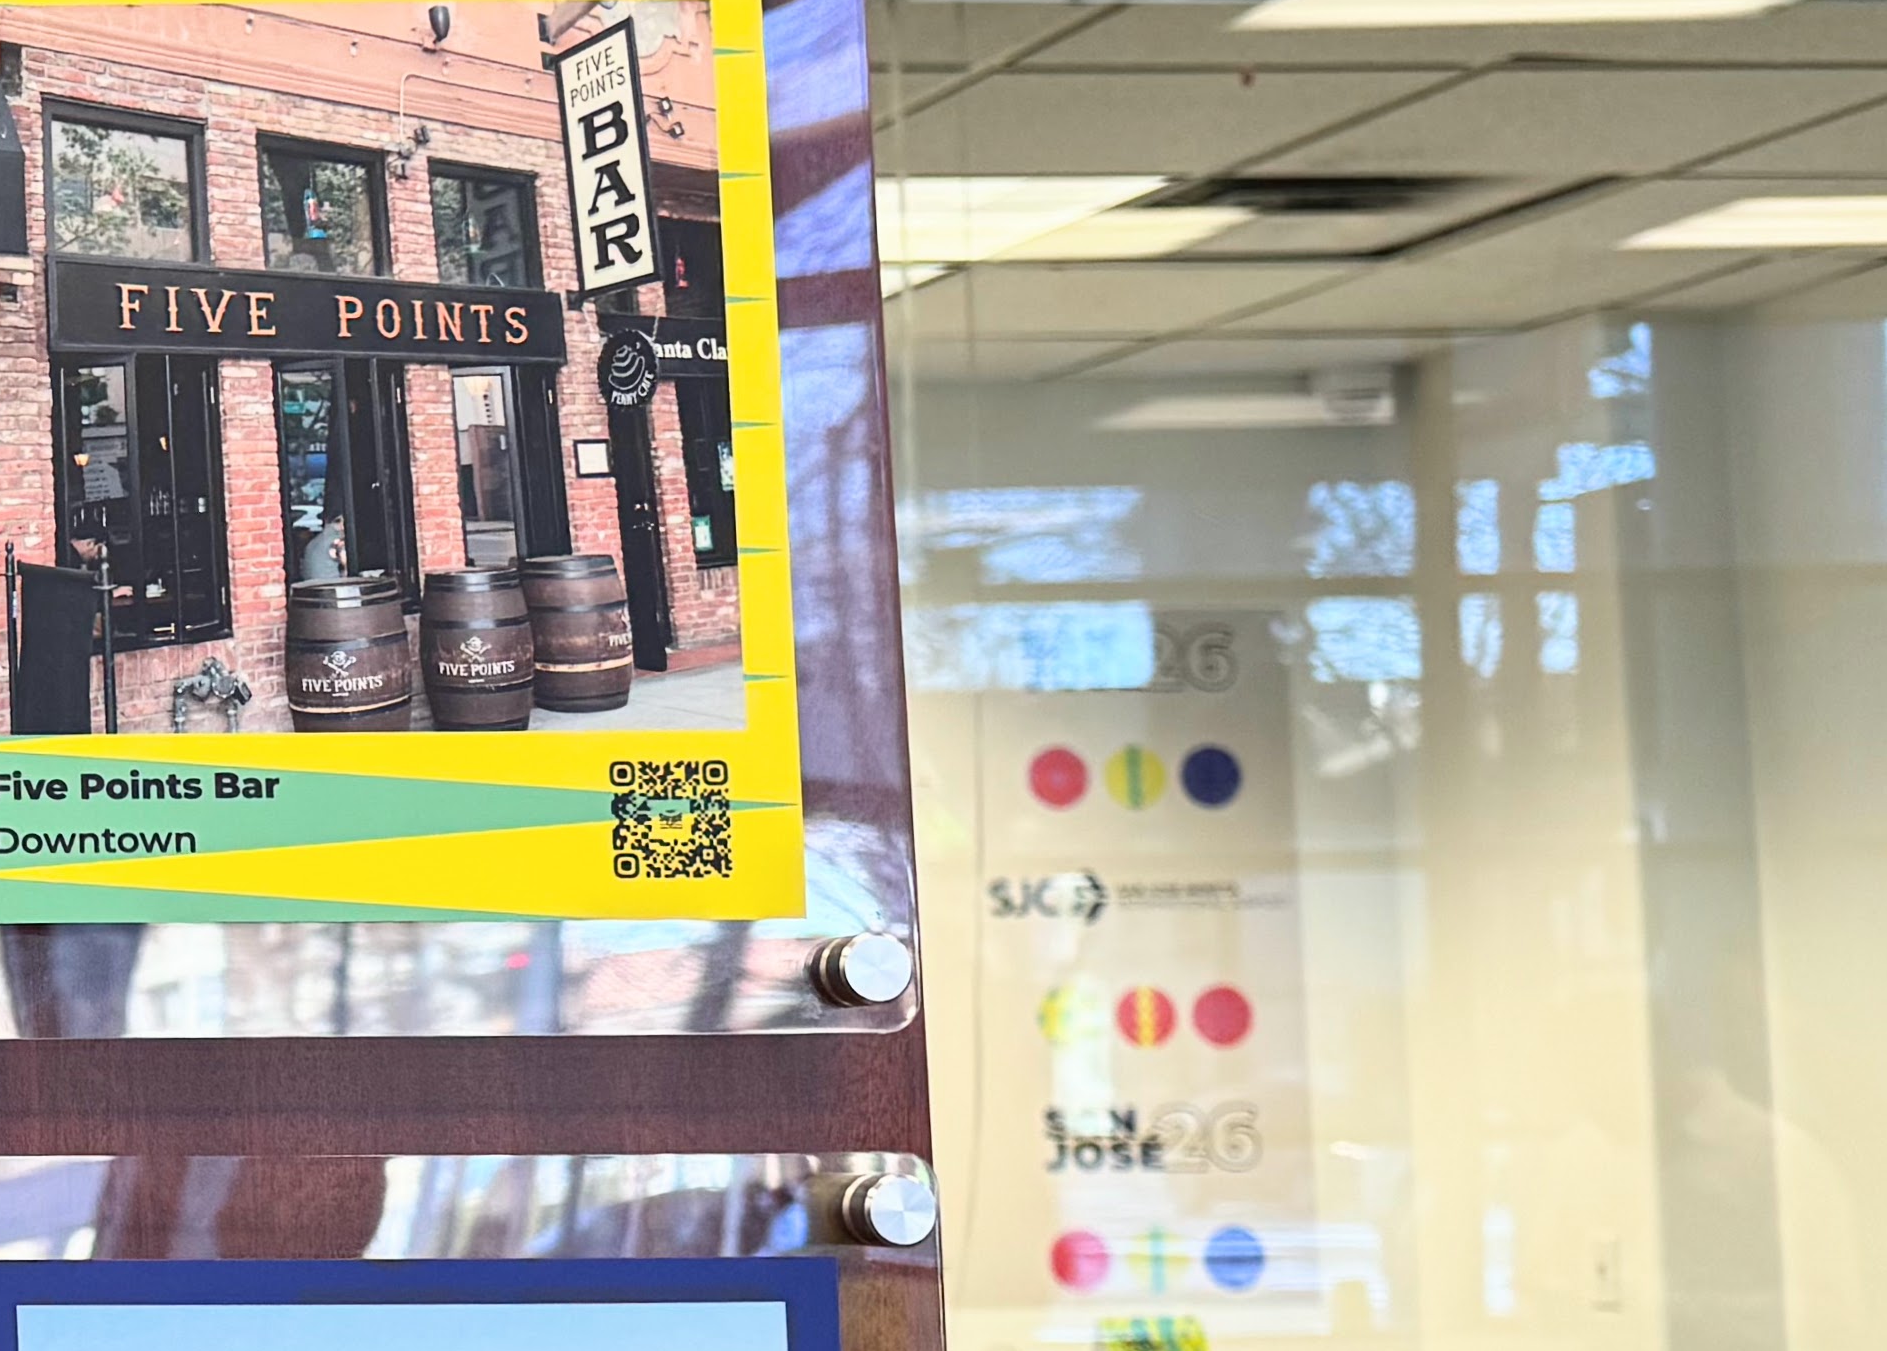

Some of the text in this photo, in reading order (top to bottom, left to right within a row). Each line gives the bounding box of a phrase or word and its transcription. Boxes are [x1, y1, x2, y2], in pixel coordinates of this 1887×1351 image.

[576, 45, 616, 81] FIVE
[570, 66, 626, 108] POINTS
[577, 100, 643, 271] BAR
[115, 282, 530, 345] FIVE POINTS
[653, 340, 693, 359] anta
[611, 390, 637, 406] PENNY
[301, 675, 383, 693] FIVE POINTS
[438, 660, 516, 677] FIVE POINTS
[81, 770, 203, 801] Points
[215, 772, 281, 800] Bar
[1044, 1108, 1138, 1140] SN
